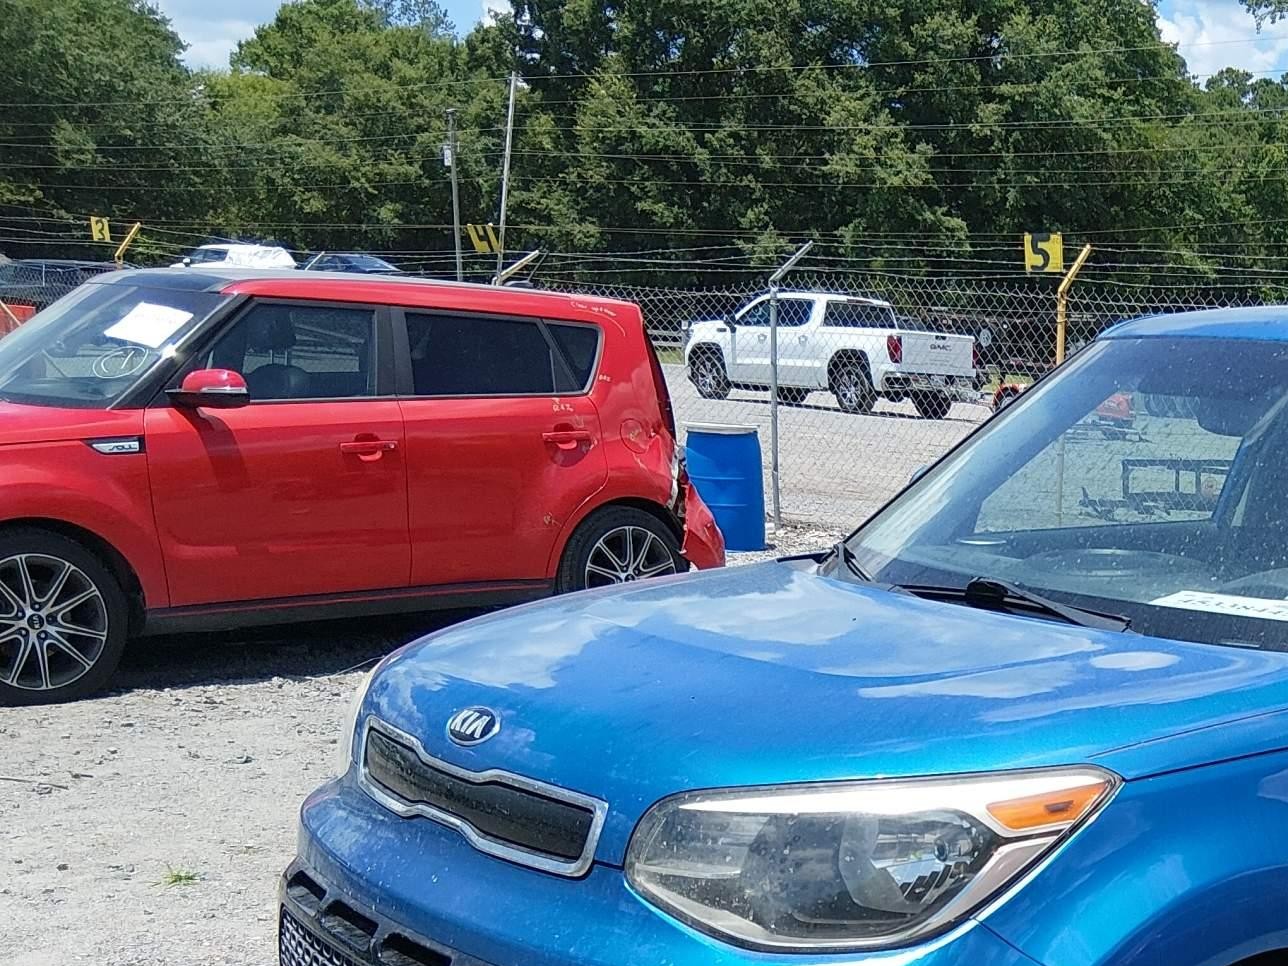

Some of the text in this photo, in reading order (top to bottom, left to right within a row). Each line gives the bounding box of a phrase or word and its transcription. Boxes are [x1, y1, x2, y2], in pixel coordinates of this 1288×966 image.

[95, 218, 106, 241] 3
[473, 225, 494, 252] 4
[1031, 232, 1050, 271] 5
[930, 343, 953, 352] GMC
[450, 709, 492, 739] KIA
